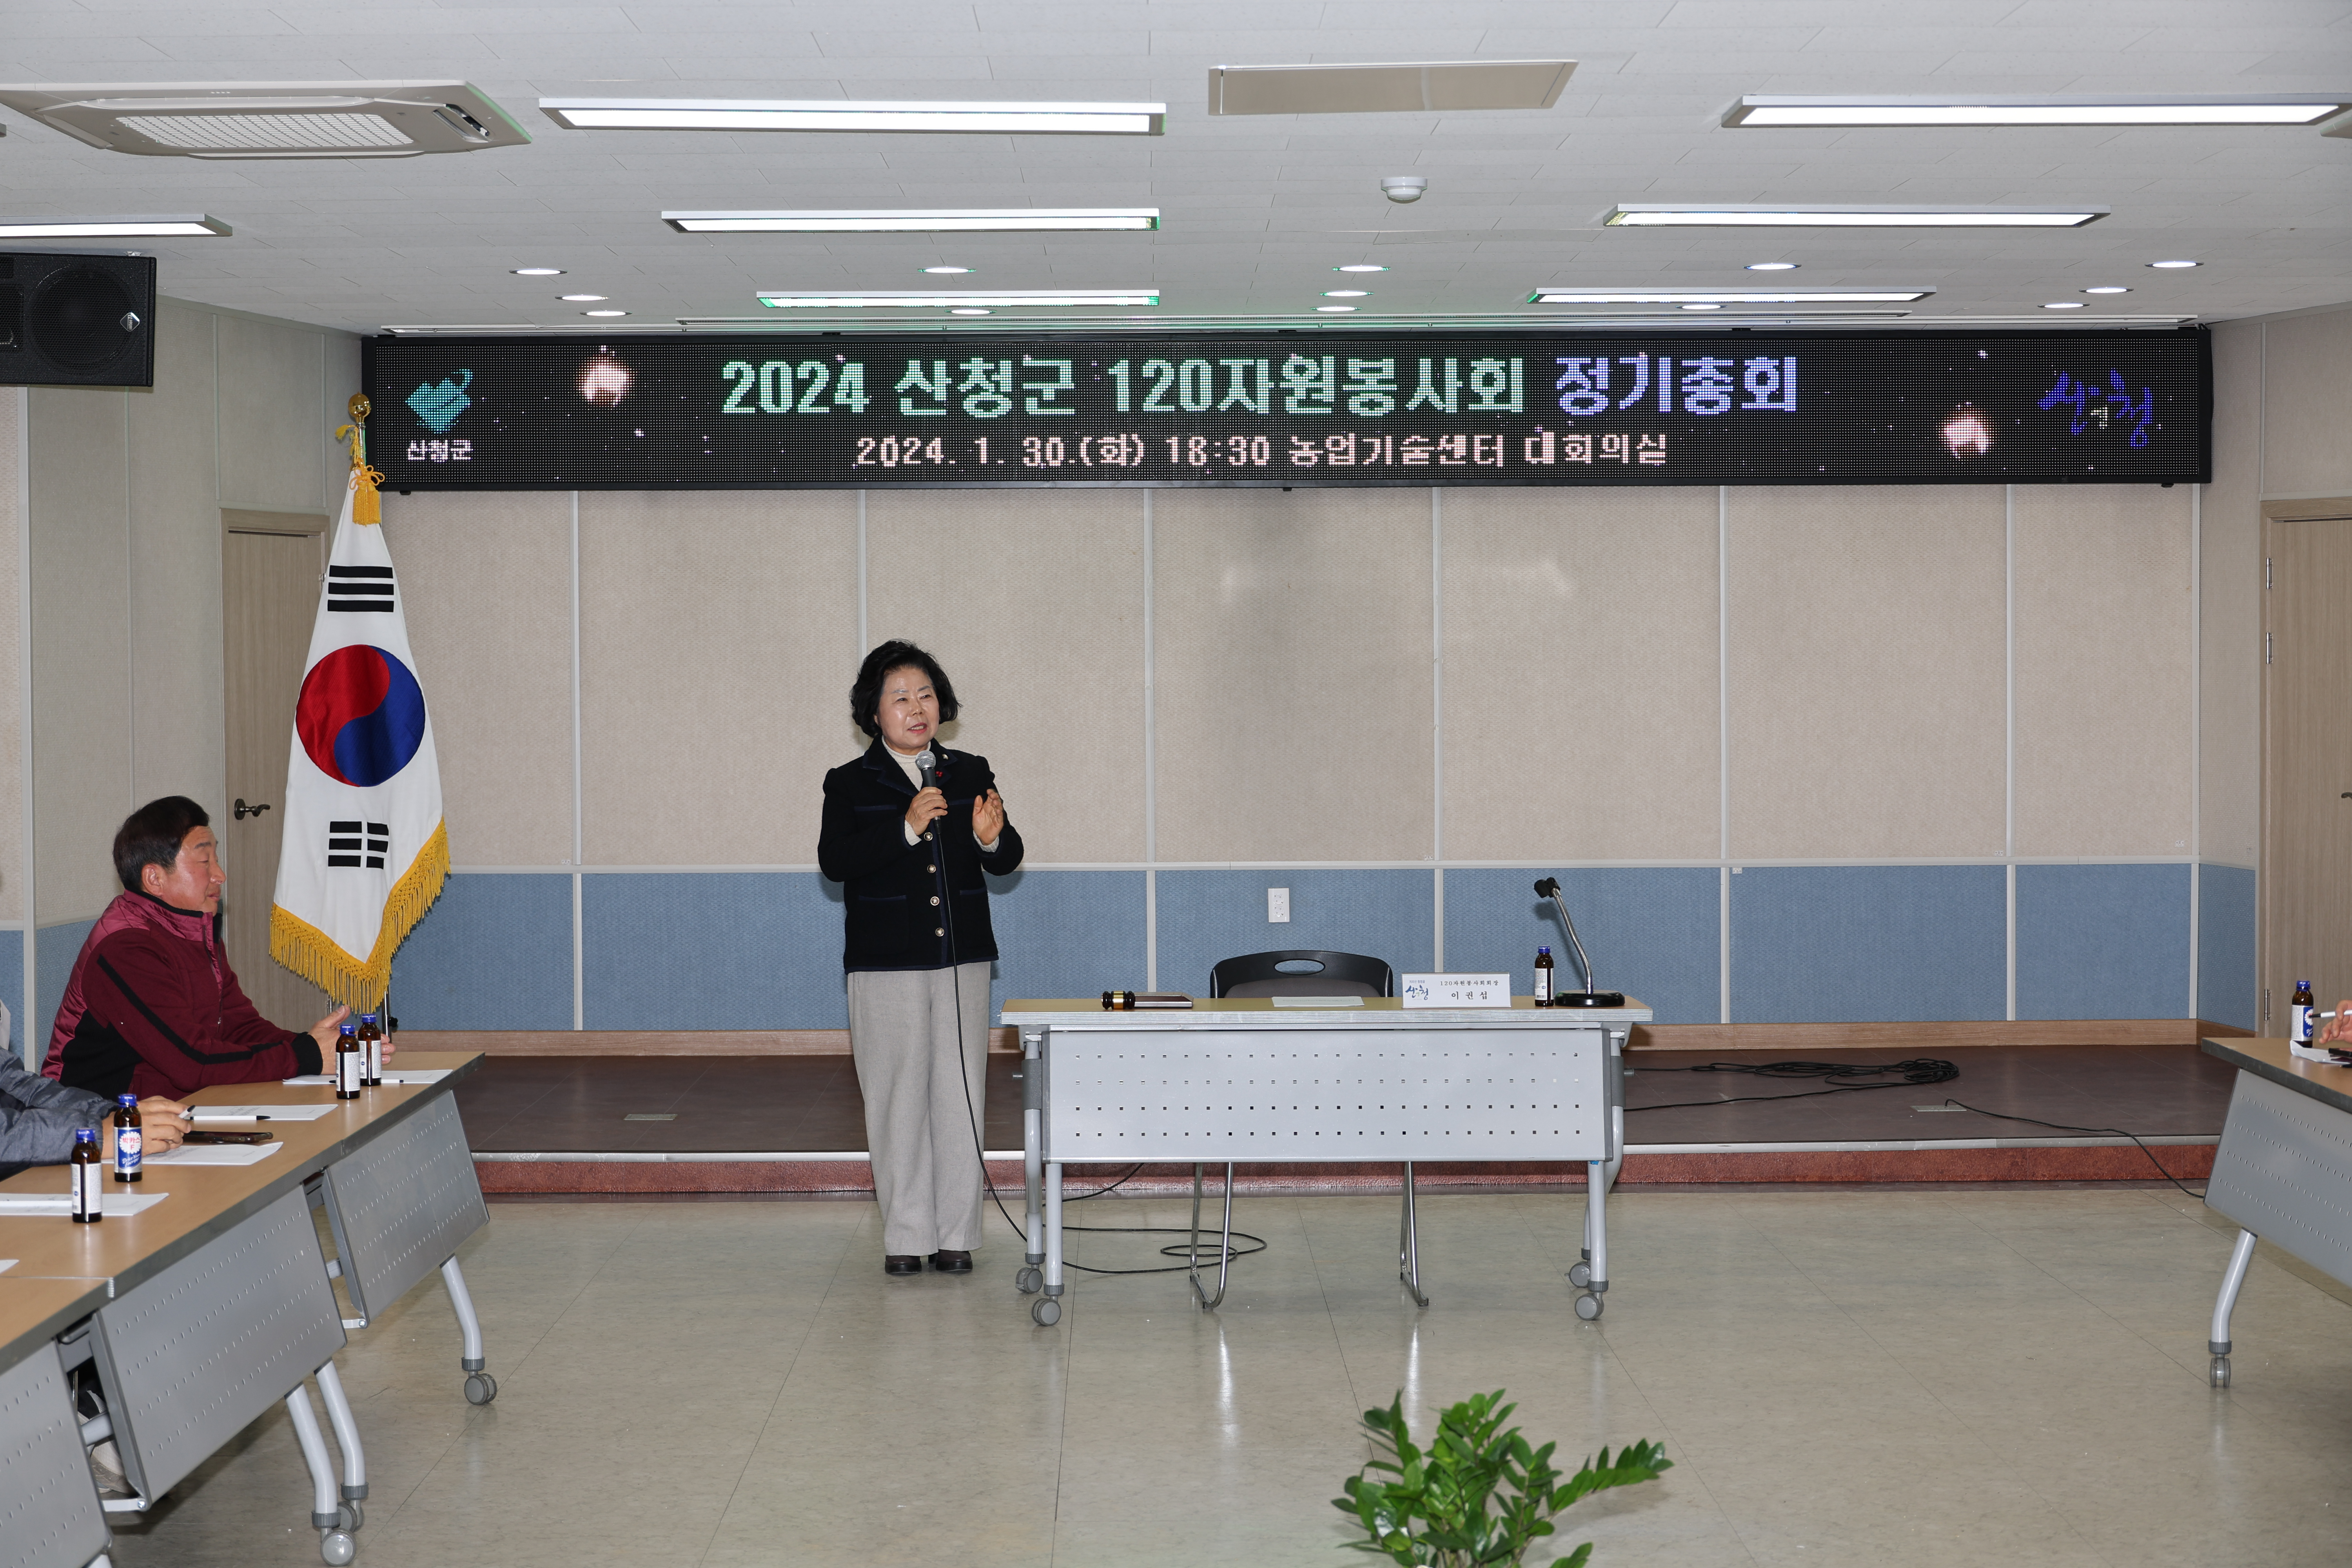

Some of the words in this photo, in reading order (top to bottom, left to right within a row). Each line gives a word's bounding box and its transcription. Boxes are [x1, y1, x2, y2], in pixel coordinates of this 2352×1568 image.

[722, 361, 869, 414] 2024
[893, 358, 1075, 418] 산청군
[1107, 355, 1524, 416] 120자원봉사회
[1555, 354, 1798, 416] 정기총회
[408, 440, 473, 463] 산청군
[857, 437, 956, 466] 2024.
[974, 437, 1004, 464] 1.
[1022, 434, 1145, 466] 30.(화)
[1165, 436, 1270, 466] 18:30
[1289, 433, 1504, 467] 농업기술센터
[1524, 432, 1666, 466] 대회의실
